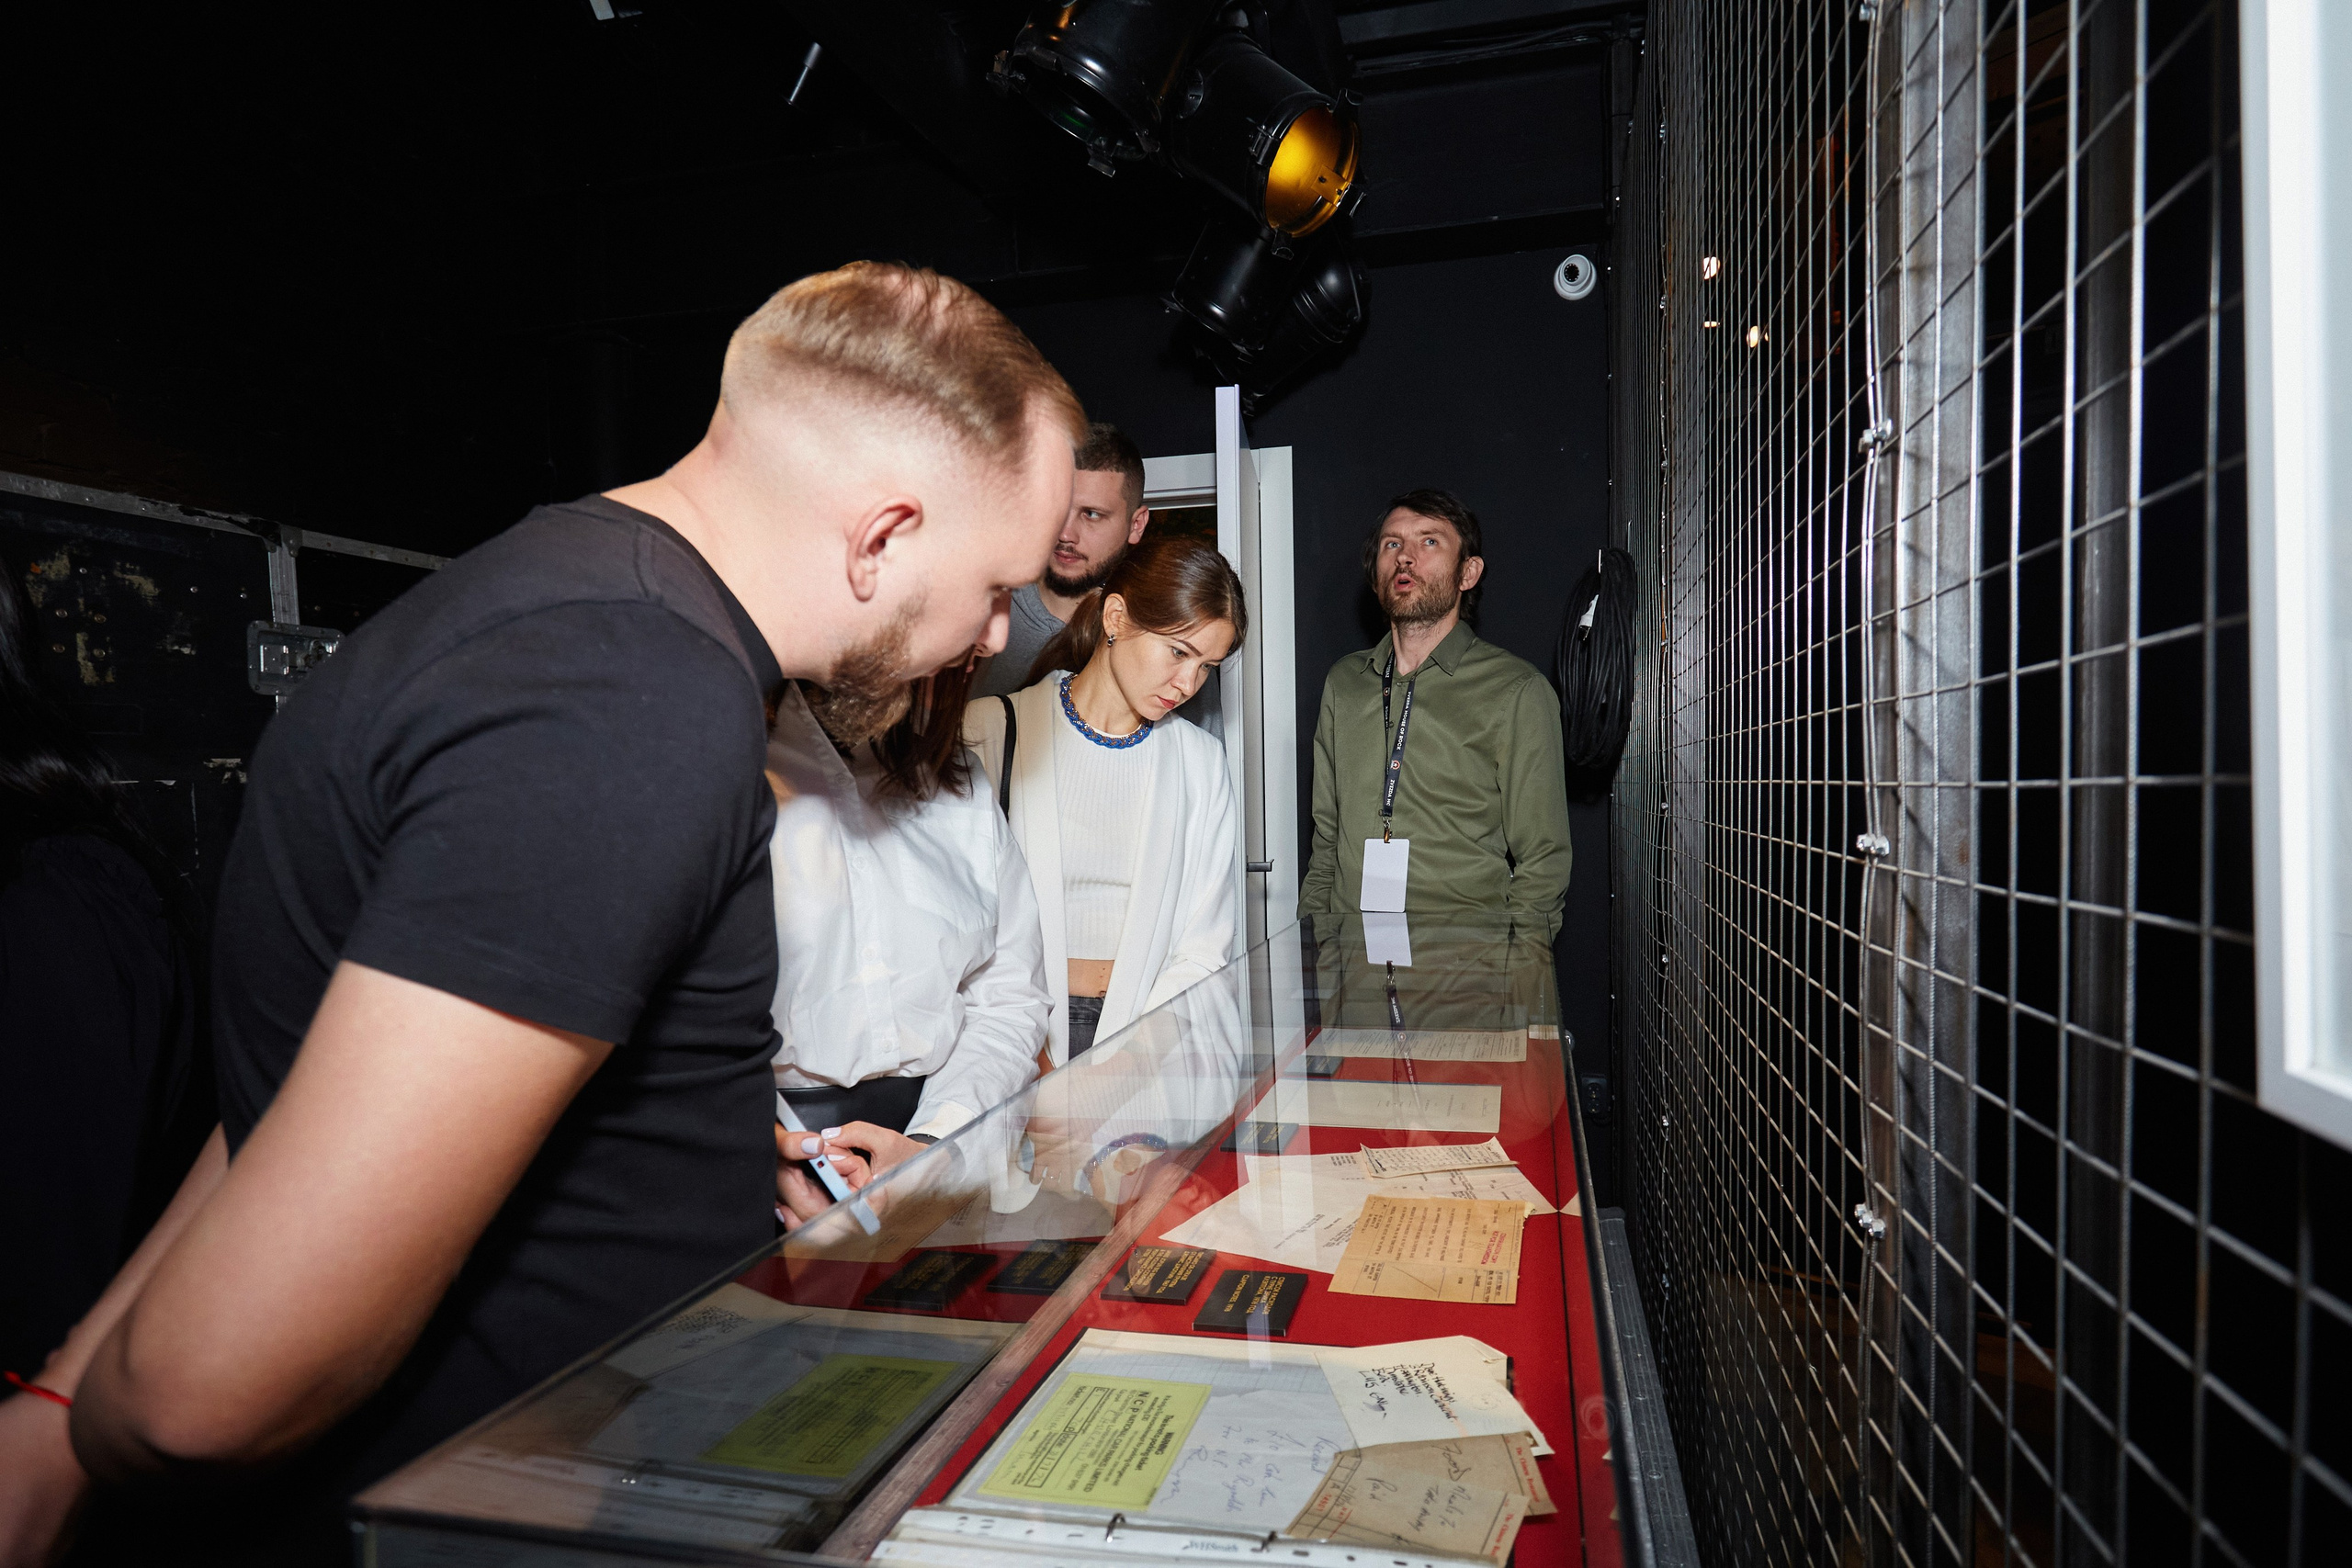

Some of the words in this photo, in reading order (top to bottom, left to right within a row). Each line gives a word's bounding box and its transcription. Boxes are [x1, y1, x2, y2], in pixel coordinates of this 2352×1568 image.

[1235, 1274, 1250, 1290] CLAPTON
[1115, 1414, 1137, 1438] NATIONAL
[1109, 1438, 1123, 1449] CAR
[1139, 1438, 1159, 1456] parking
[1153, 1431, 1174, 1455] WARNING
[1097, 1450, 1115, 1467] PARKS
[1134, 1457, 1149, 1471] ticket
[1520, 1458, 1530, 1476] Chinese
[1081, 1468, 1104, 1492] LIMITED
